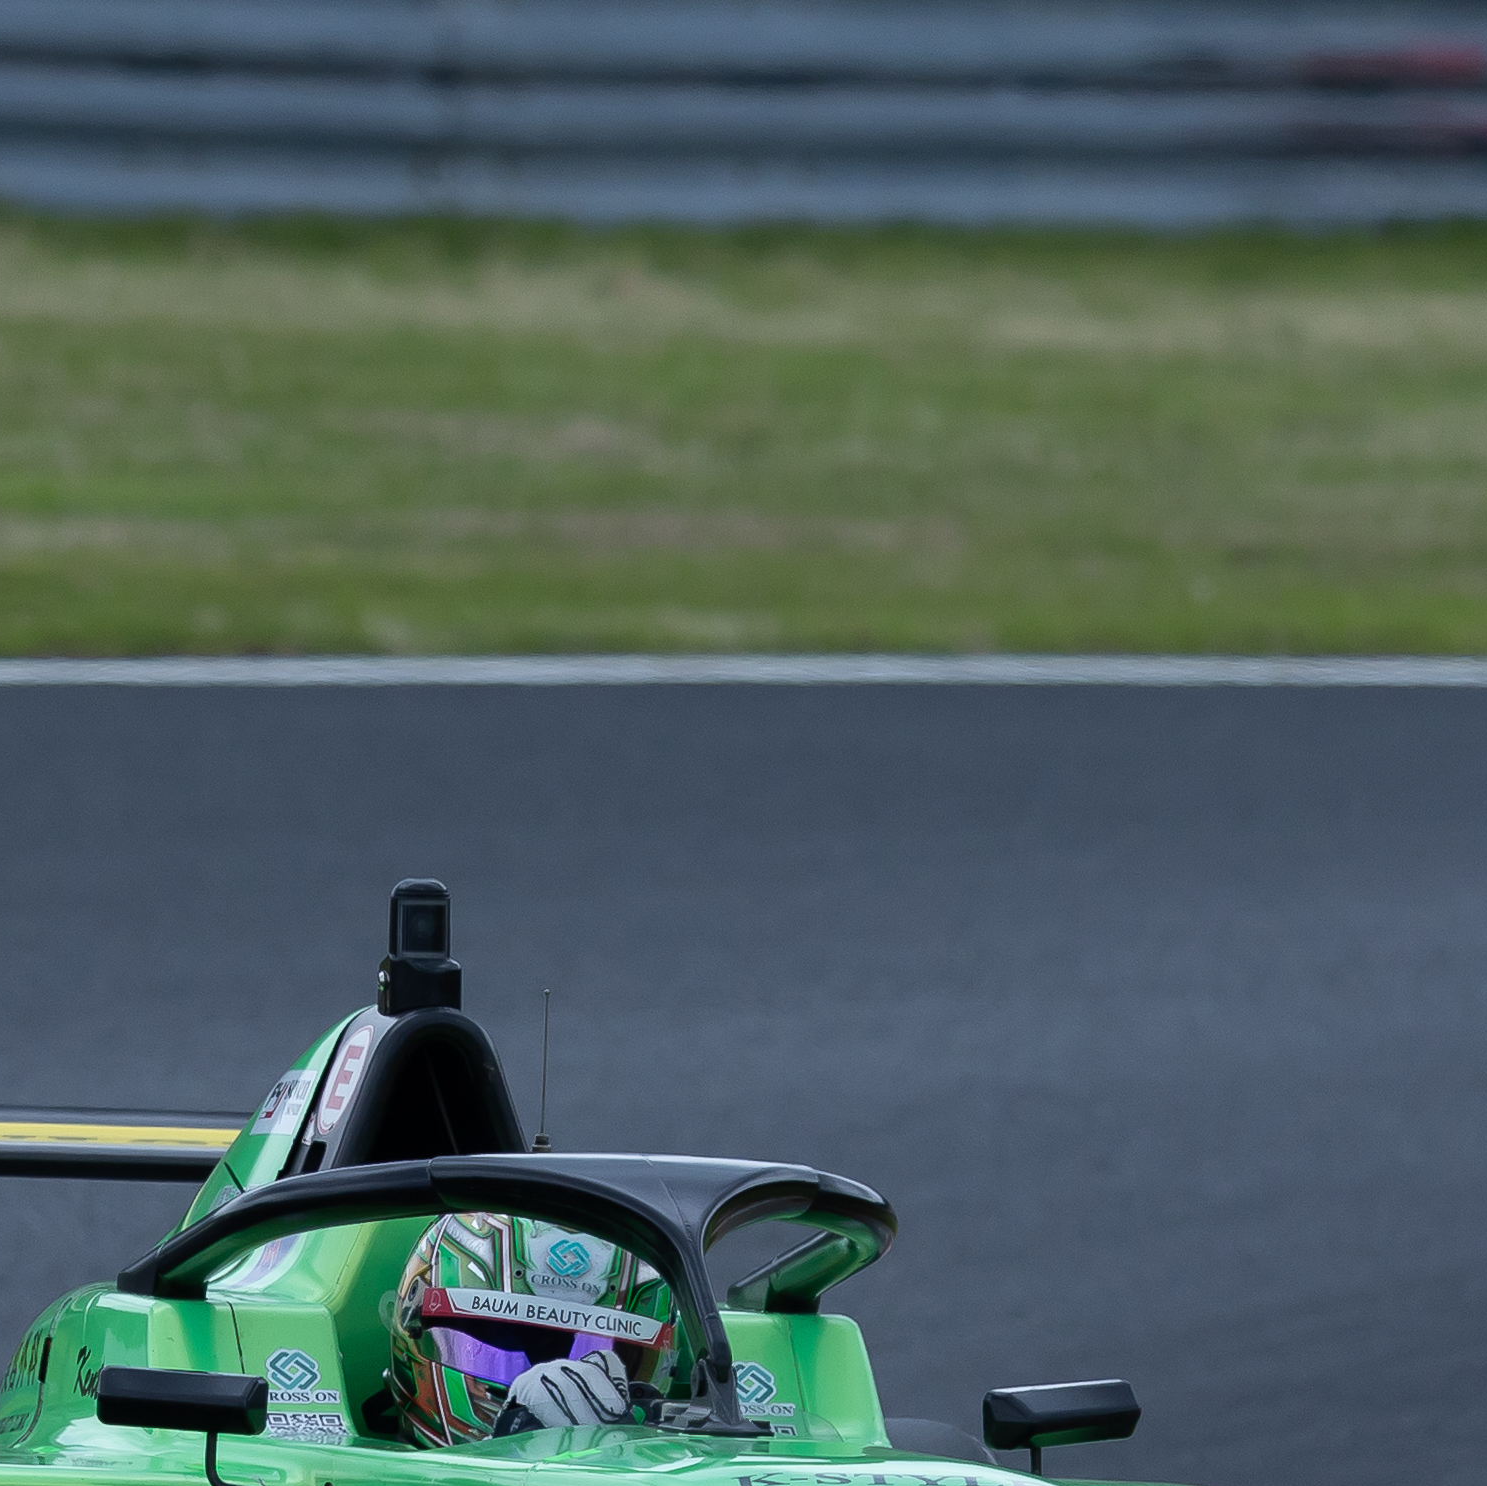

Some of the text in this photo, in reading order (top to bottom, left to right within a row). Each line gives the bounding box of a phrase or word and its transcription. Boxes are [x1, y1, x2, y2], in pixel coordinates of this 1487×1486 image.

[531, 1274, 602, 1296] CROSS ON
[471, 1295, 642, 1336] BAUM BEAUTY CLINIC
[269, 1391, 338, 1402] ROSS ON
[771, 1405, 794, 1416] ON
